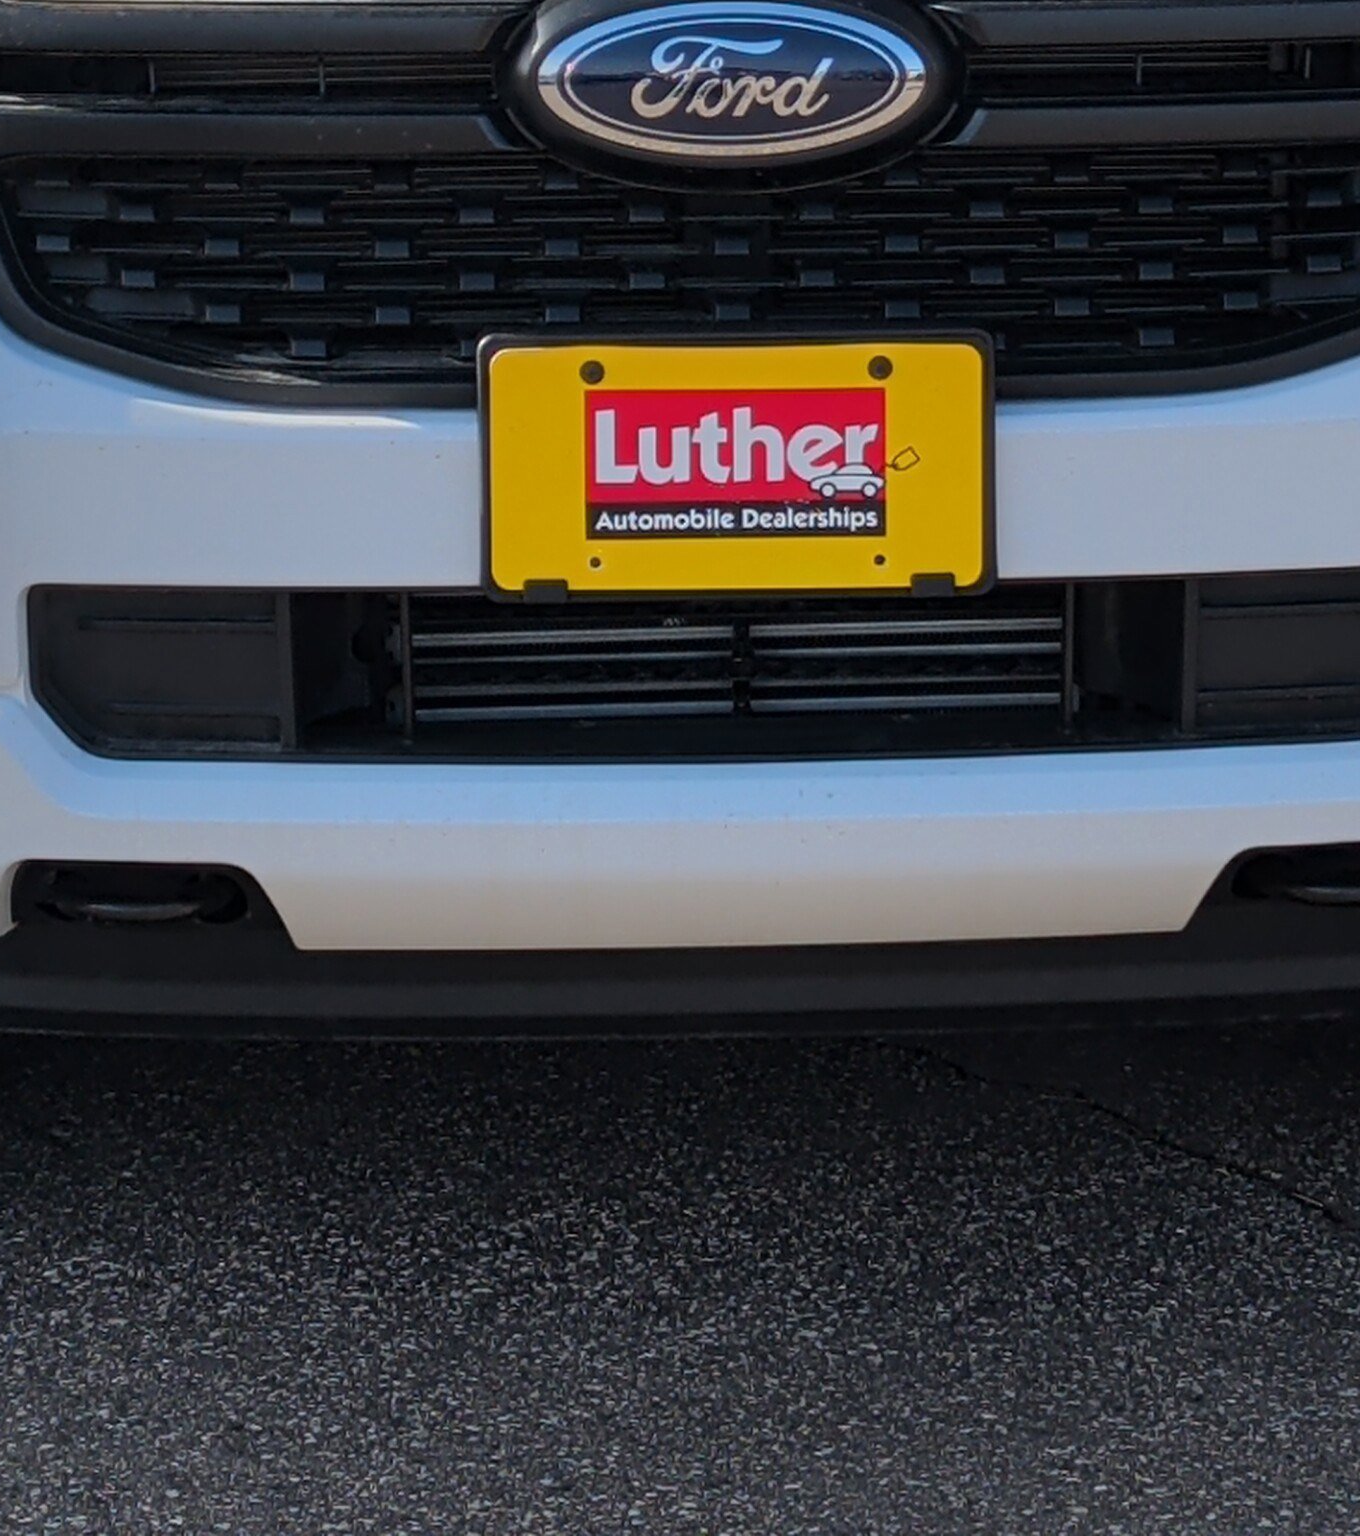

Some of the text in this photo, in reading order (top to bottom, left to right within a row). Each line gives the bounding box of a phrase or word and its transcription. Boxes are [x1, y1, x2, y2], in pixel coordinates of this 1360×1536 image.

[629, 34, 835, 120] Ford
[593, 405, 879, 487] Luther
[594, 506, 878, 532] Automobile Dealerships
